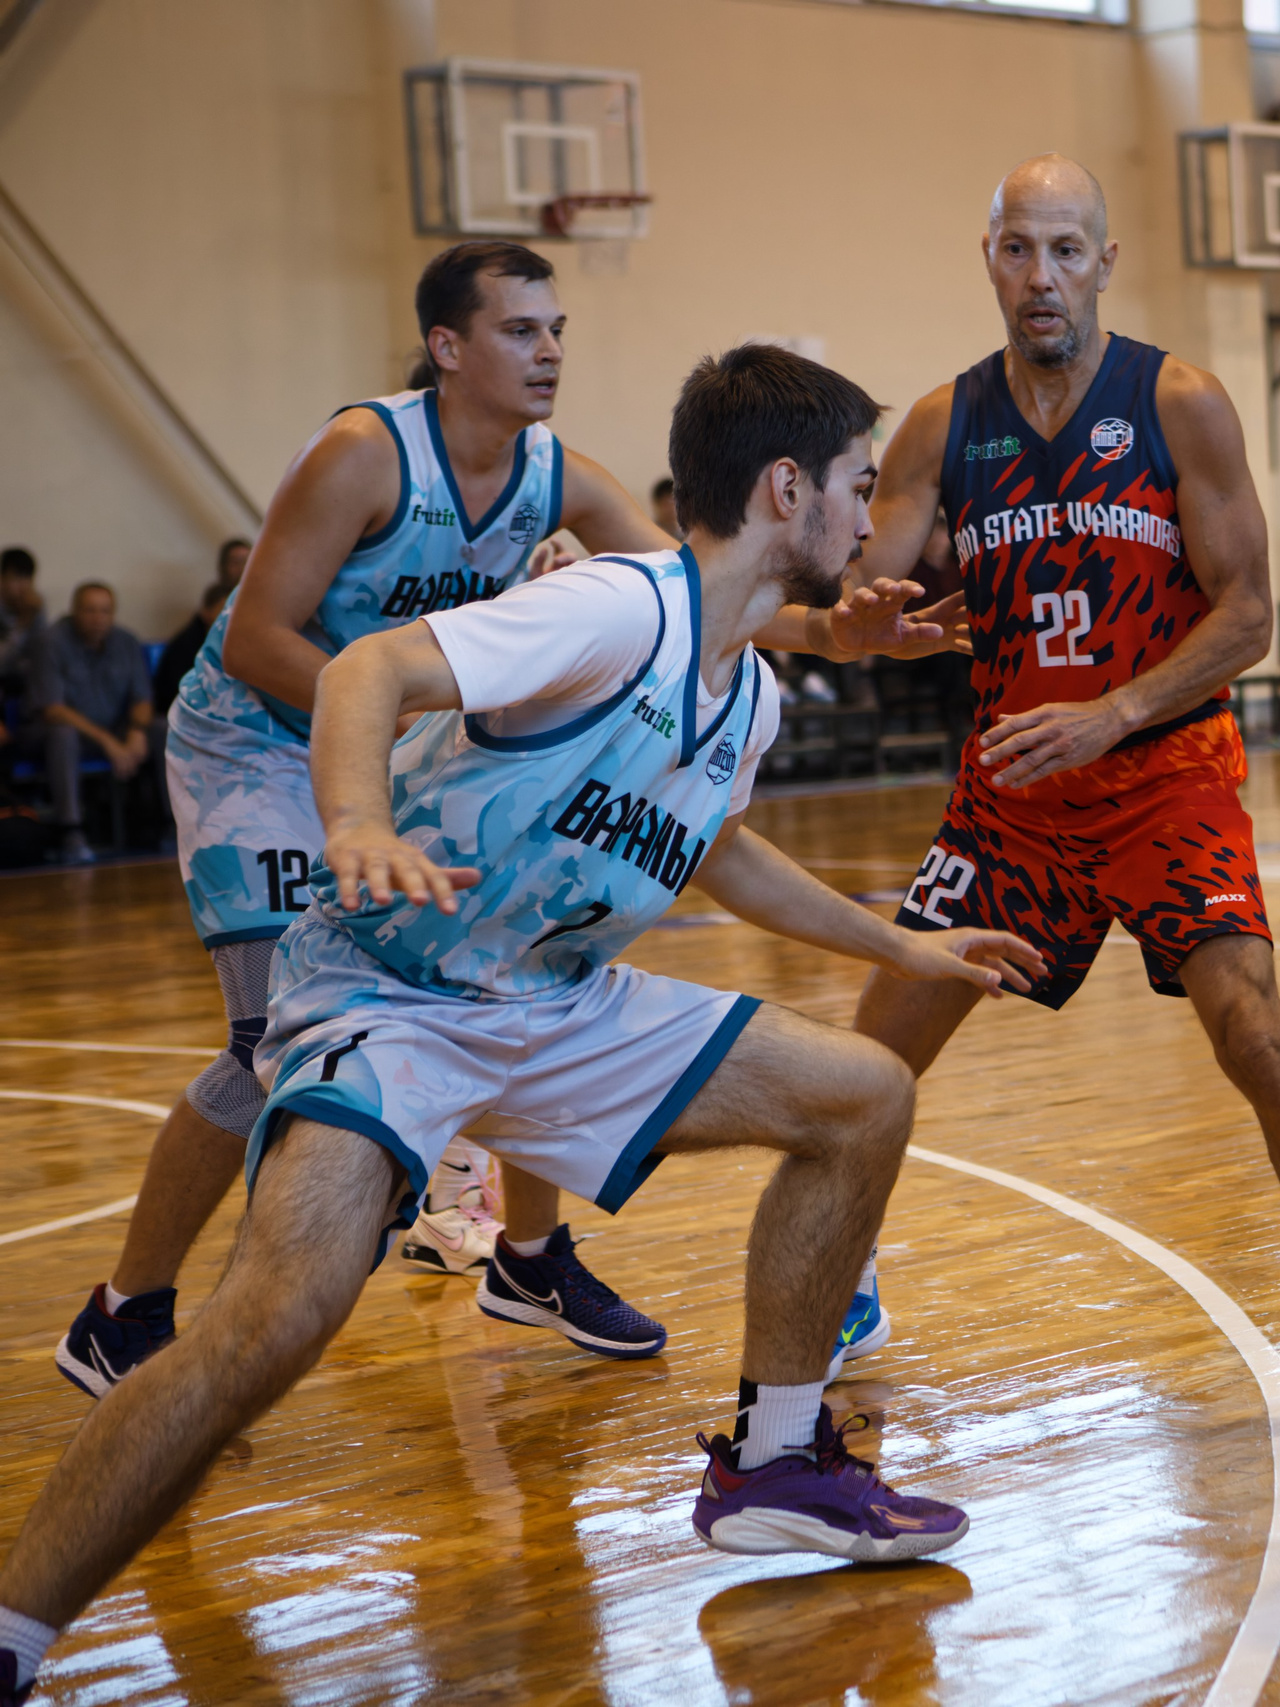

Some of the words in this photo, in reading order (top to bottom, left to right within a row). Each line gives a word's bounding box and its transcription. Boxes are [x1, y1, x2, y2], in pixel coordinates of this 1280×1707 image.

[983, 503, 1061, 551] STATE
[1067, 502, 1181, 559] WARRIORS
[1031, 590, 1094, 667] 22
[551, 778, 706, 897] ВАРАНЫ
[257, 849, 310, 912] 12
[903, 844, 975, 928] 22
[1205, 894, 1247, 906] MAXX
